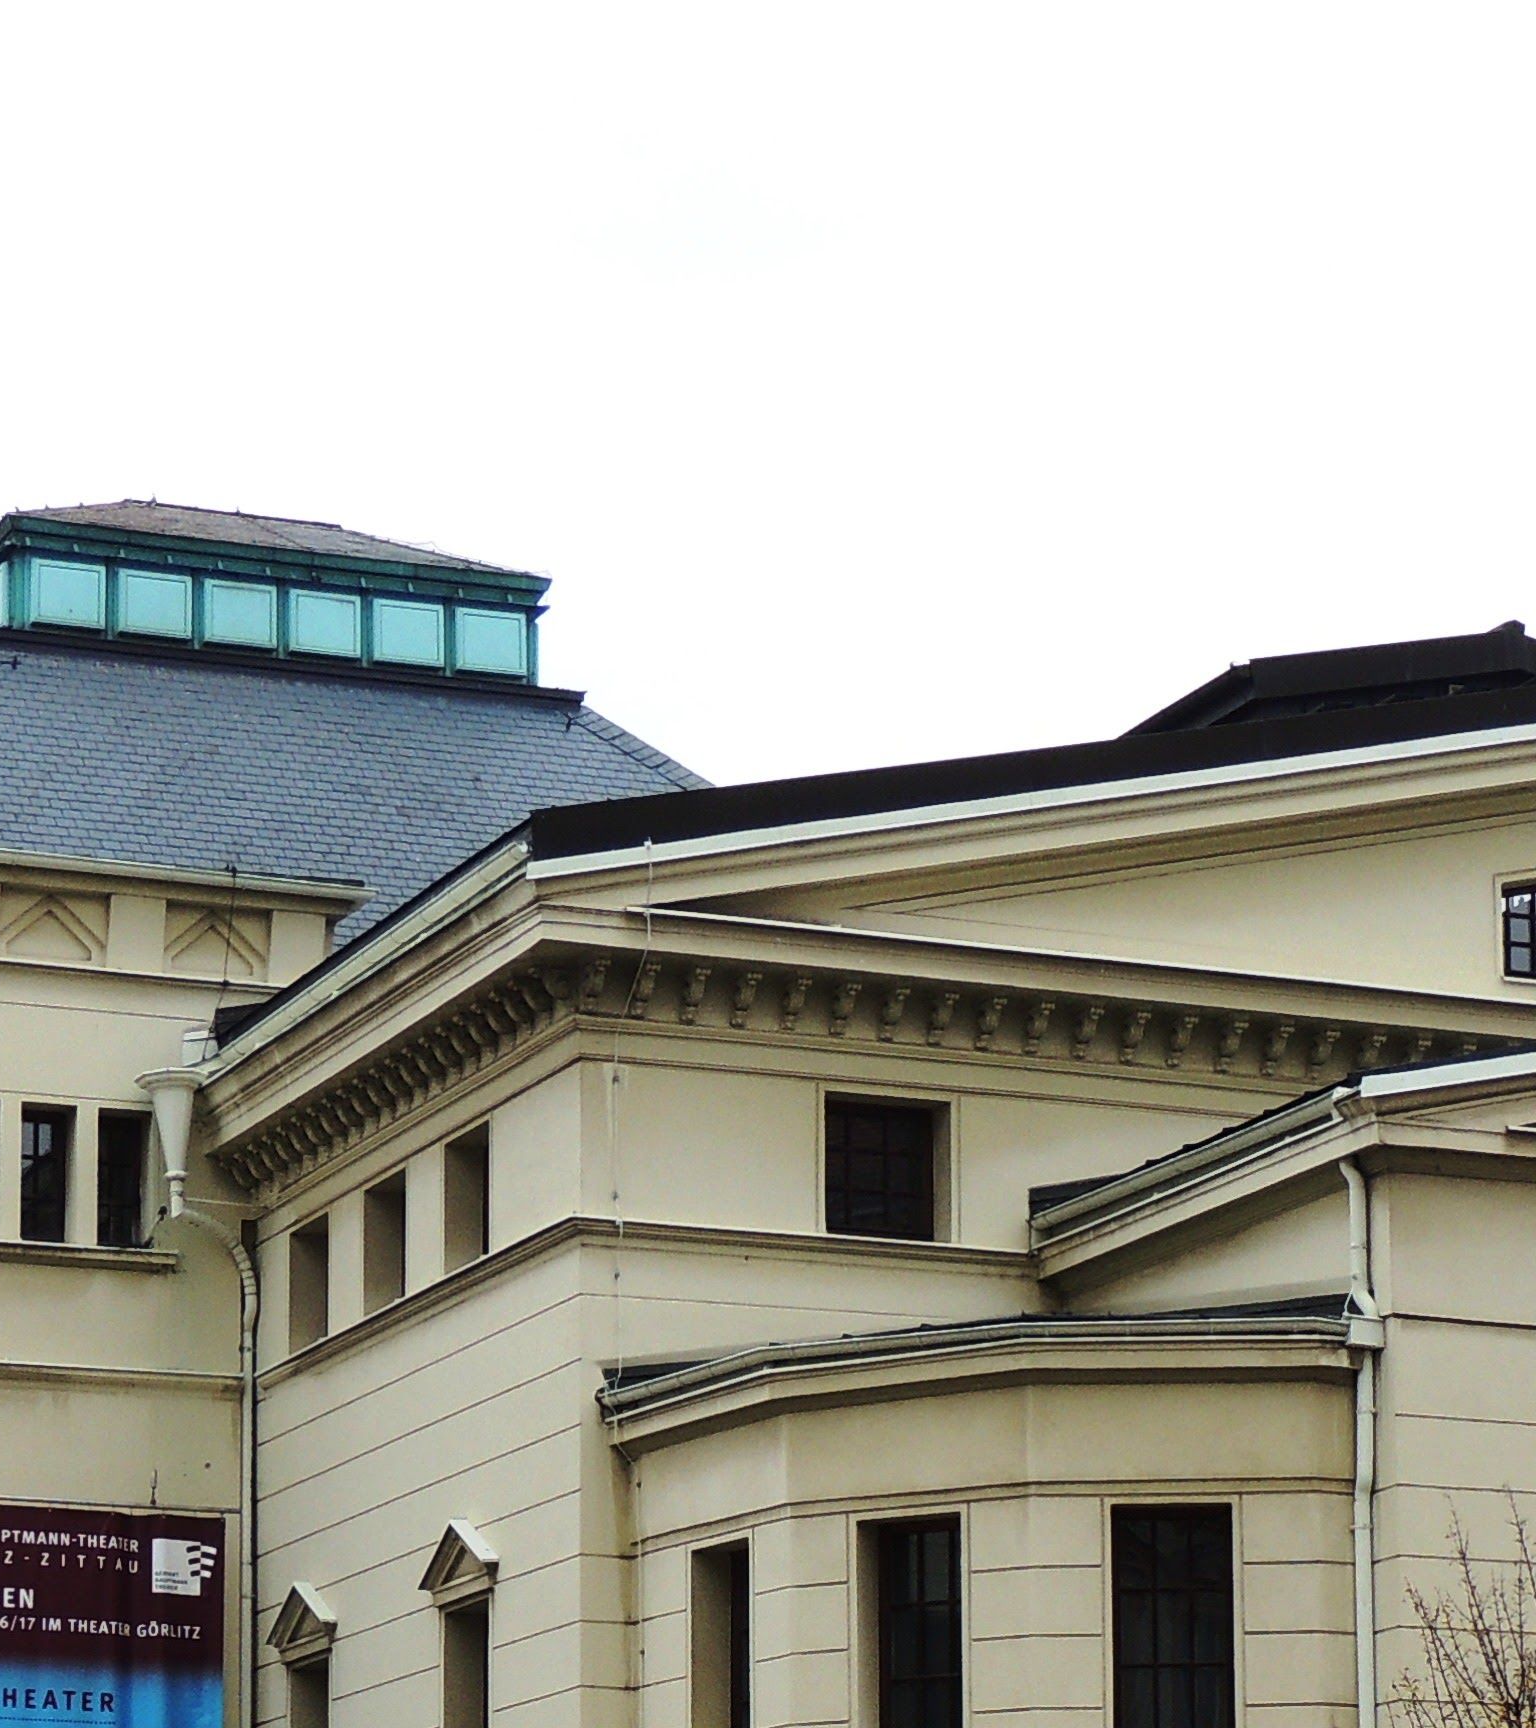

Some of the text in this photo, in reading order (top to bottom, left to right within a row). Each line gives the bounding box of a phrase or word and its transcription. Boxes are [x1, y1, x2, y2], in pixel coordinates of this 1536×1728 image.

[42, 1617, 62, 1632] IM
[68, 1618, 131, 1637] THEATER
[136, 1620, 201, 1640] GÖRLITZ
